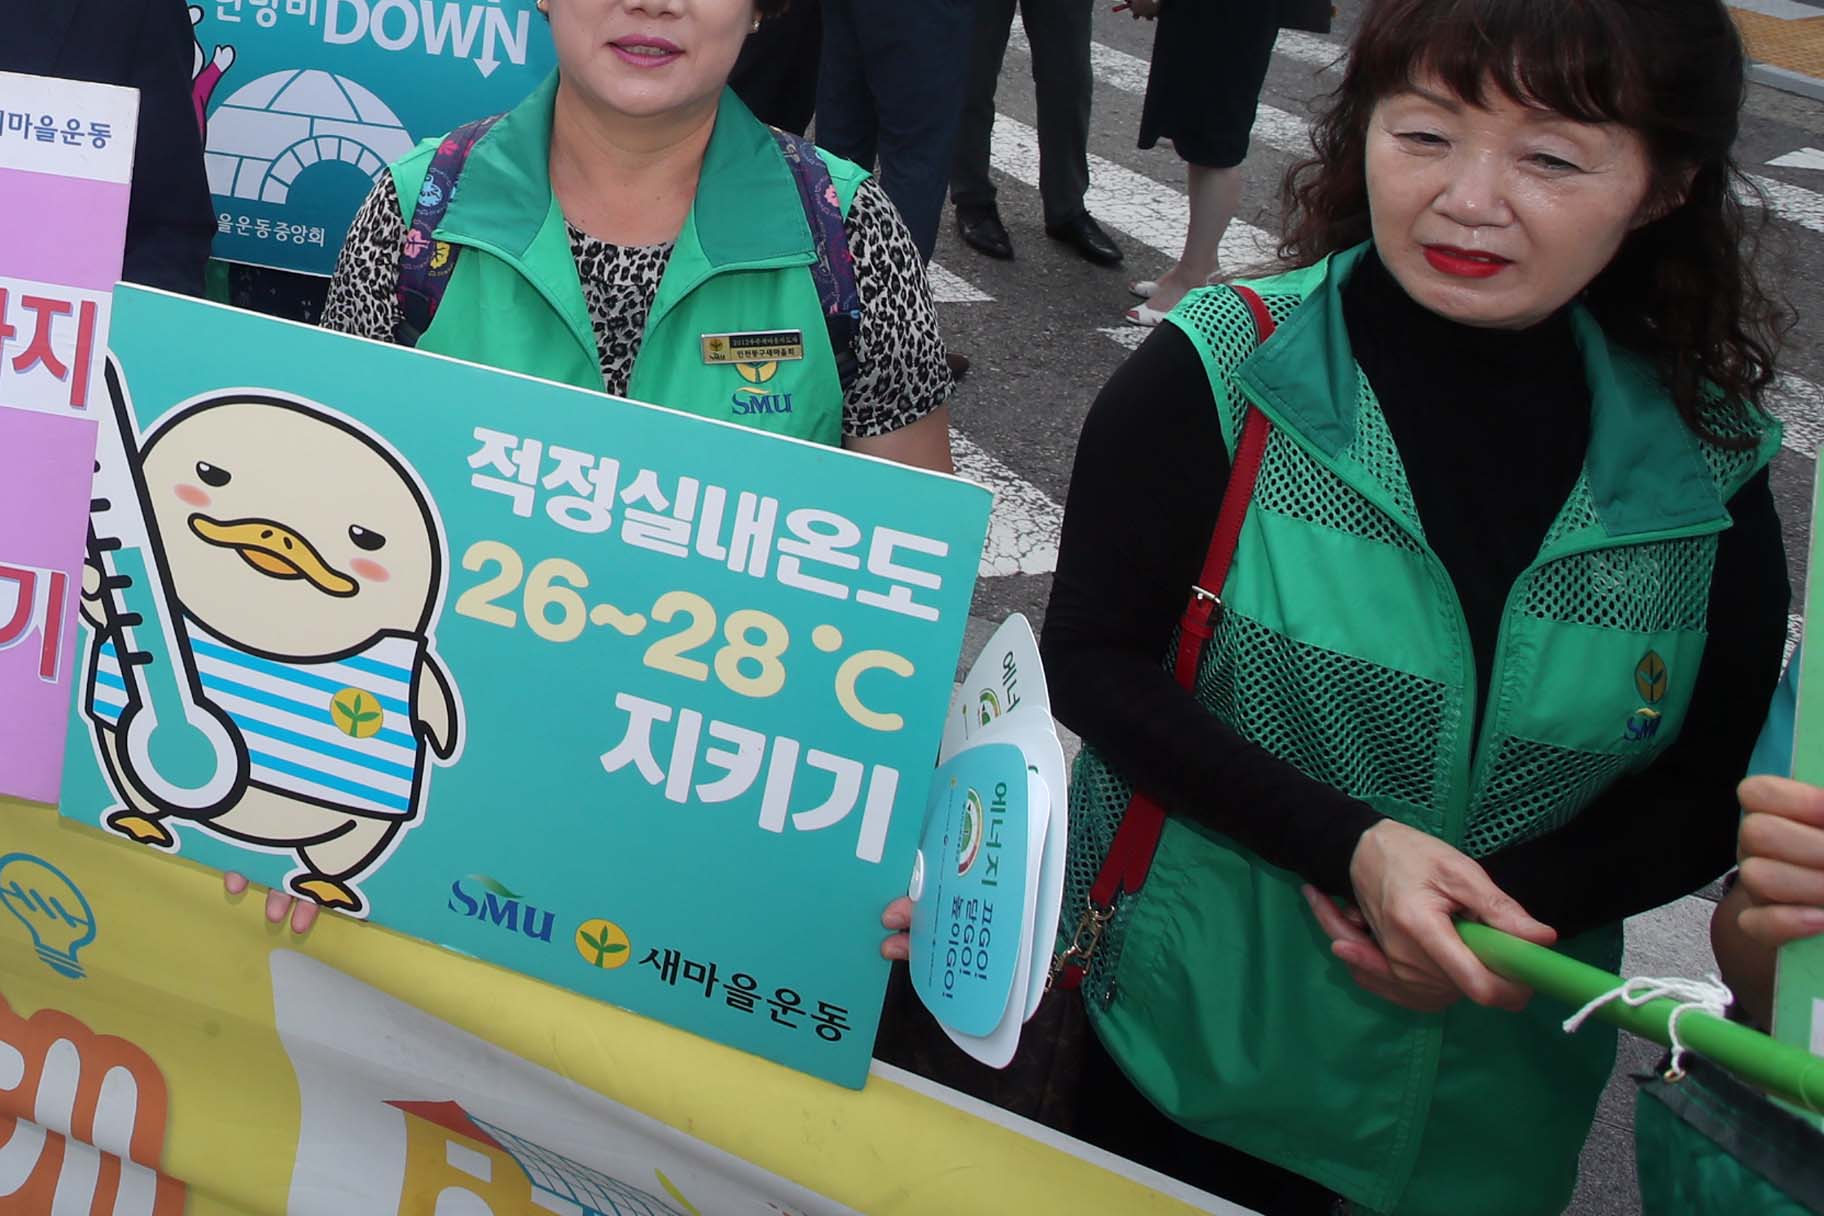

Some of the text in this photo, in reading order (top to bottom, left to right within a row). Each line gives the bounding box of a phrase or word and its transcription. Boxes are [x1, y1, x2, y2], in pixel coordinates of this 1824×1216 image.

[731, 390, 792, 415] SMU
[467, 426, 949, 622] 적정실내온도
[599, 692, 900, 863] 지키기
[982, 780, 1008, 887] 에너지
[447, 873, 852, 1042] SMU 새마을운동
